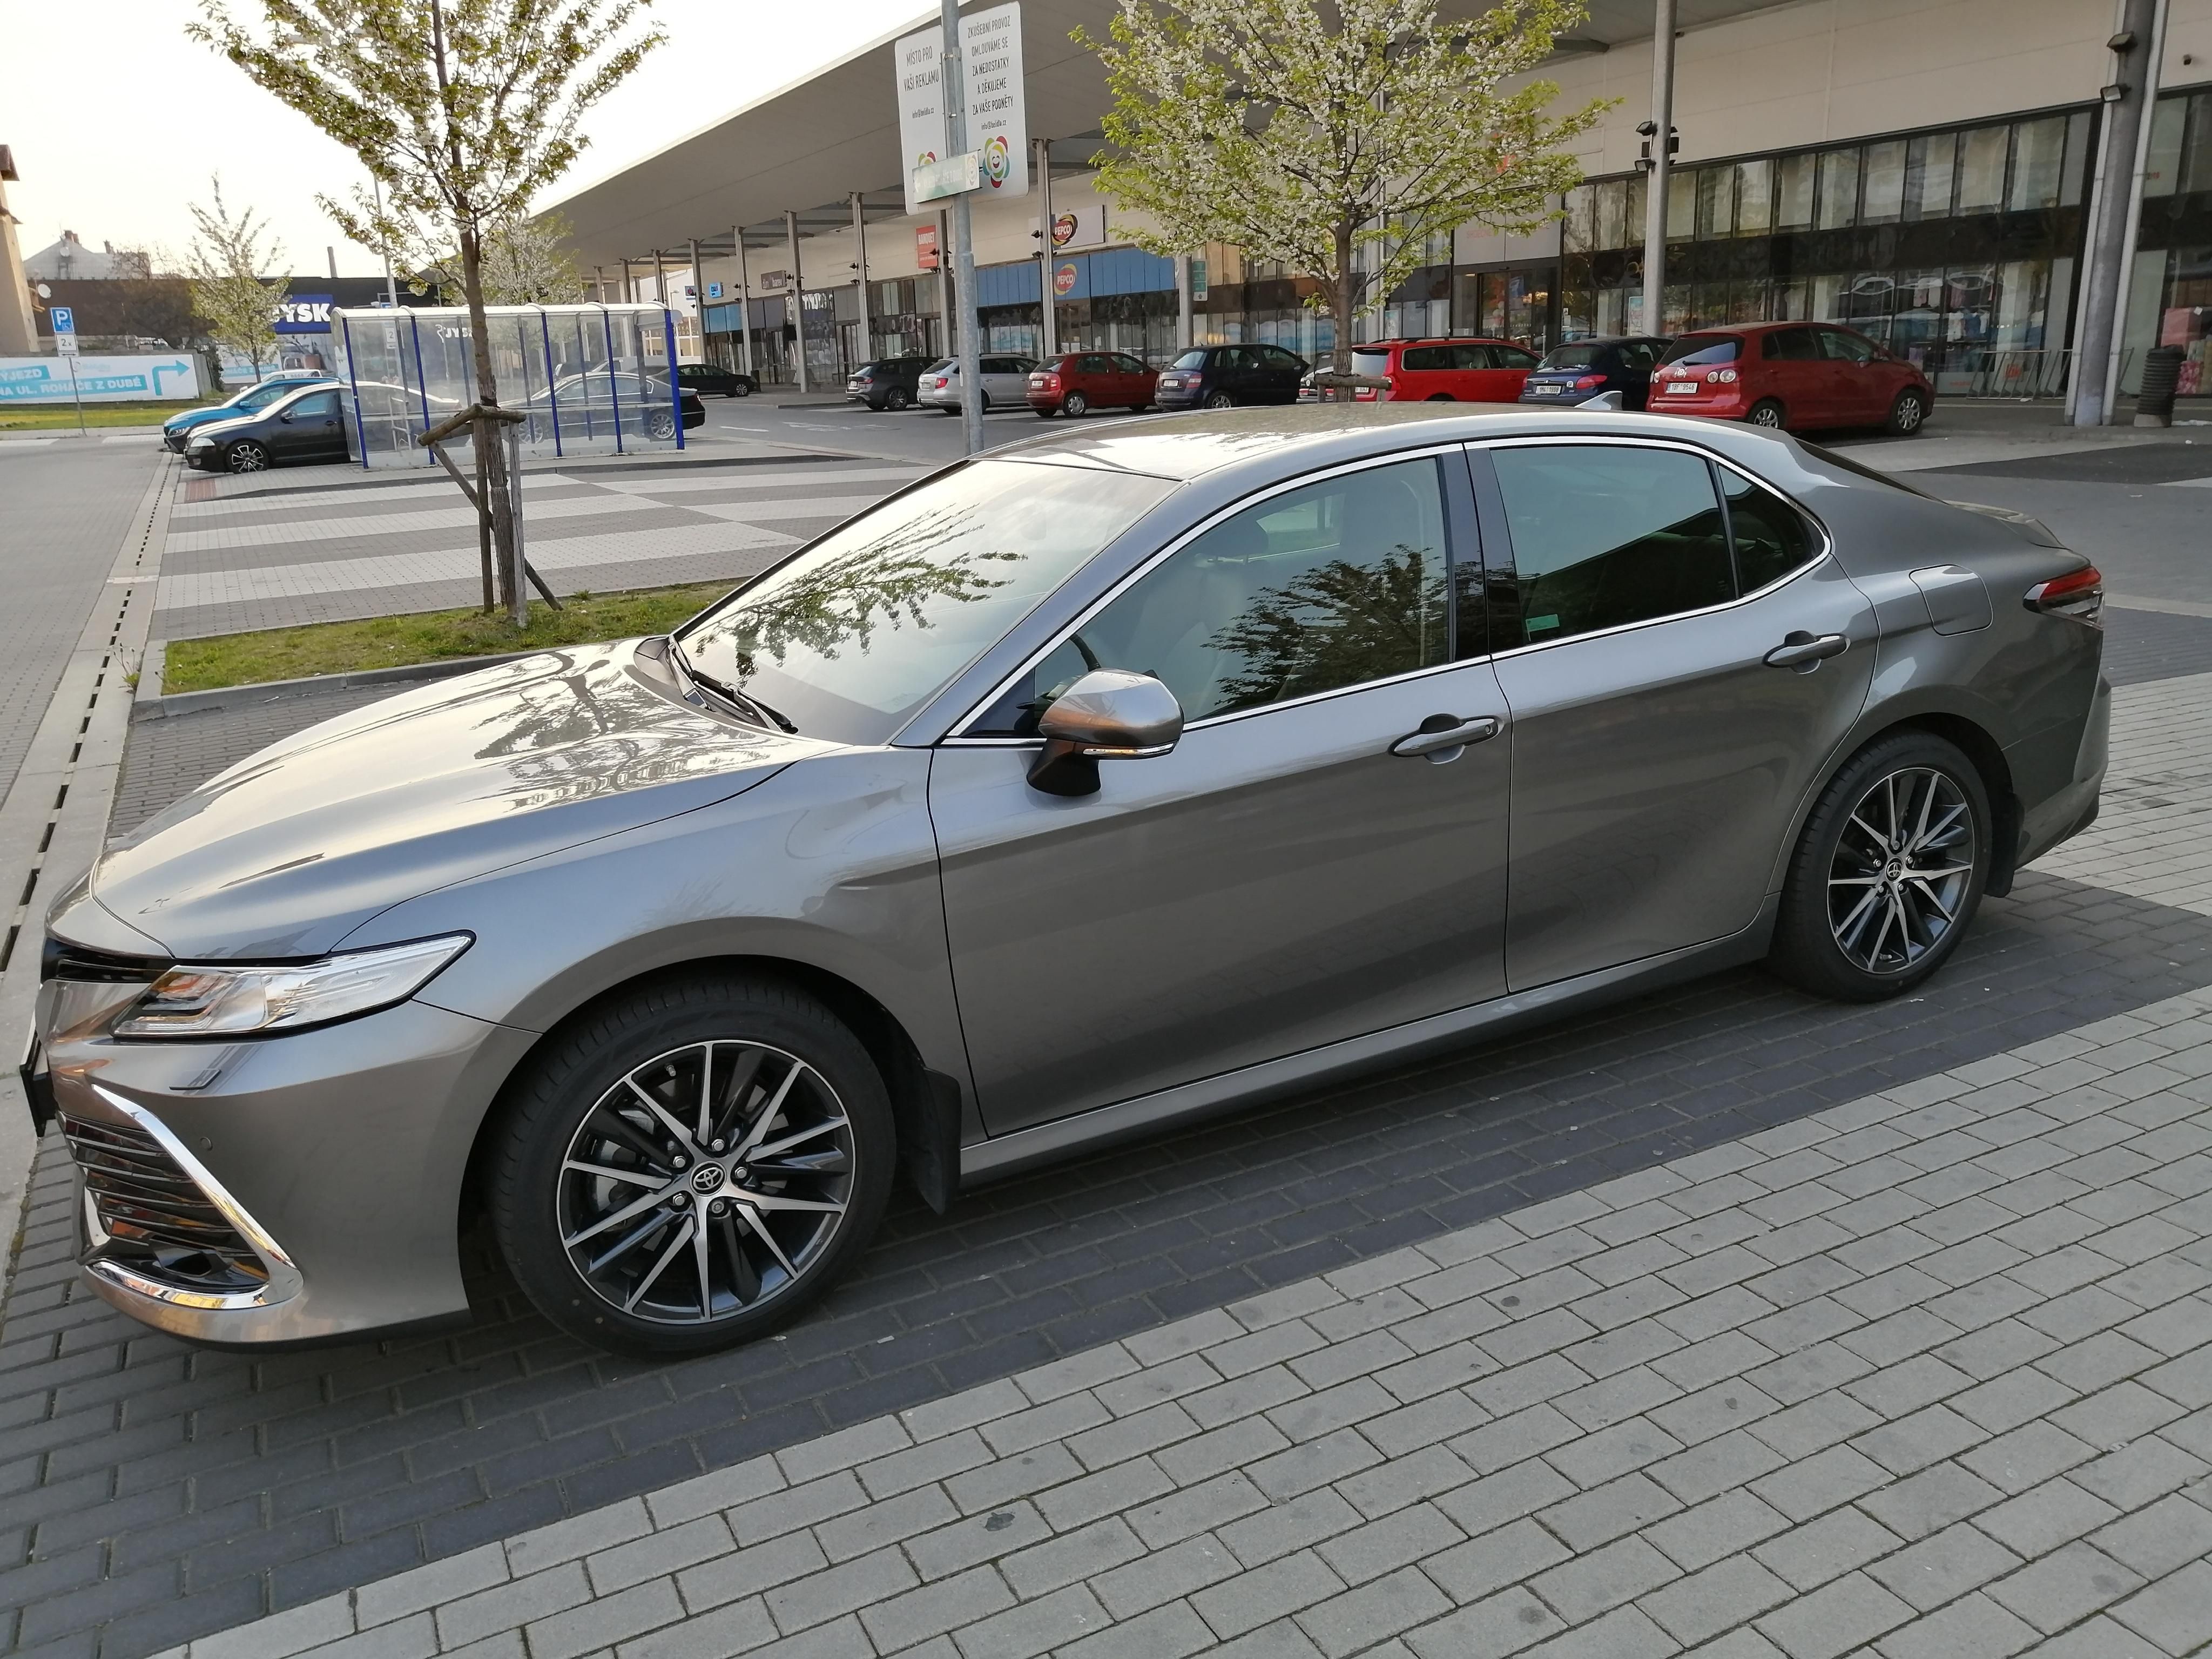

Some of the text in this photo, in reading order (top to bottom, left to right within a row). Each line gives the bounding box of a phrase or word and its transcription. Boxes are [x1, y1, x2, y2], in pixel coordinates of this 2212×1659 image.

[968, 15, 1010, 38] ZKUŠEBNÍ PROVOZ
[906, 45, 933, 67] MÍSTO PRO
[972, 36, 1008, 57] OMLOUVÁME SE
[973, 56, 1009, 77] ZA NEDOSTATKY
[903, 69, 939, 92] VAŠI REKLAMU
[977, 77, 1007, 95] A DĚKUJEME
[973, 94, 1013, 115] ZA VAŠE PODNĚTY
[1055, 225, 1070, 235] PEPCO
[1057, 274, 1074, 285] PEPCO
[96, 381, 105, 389] Z
[107, 376, 141, 388] DUBÉ
